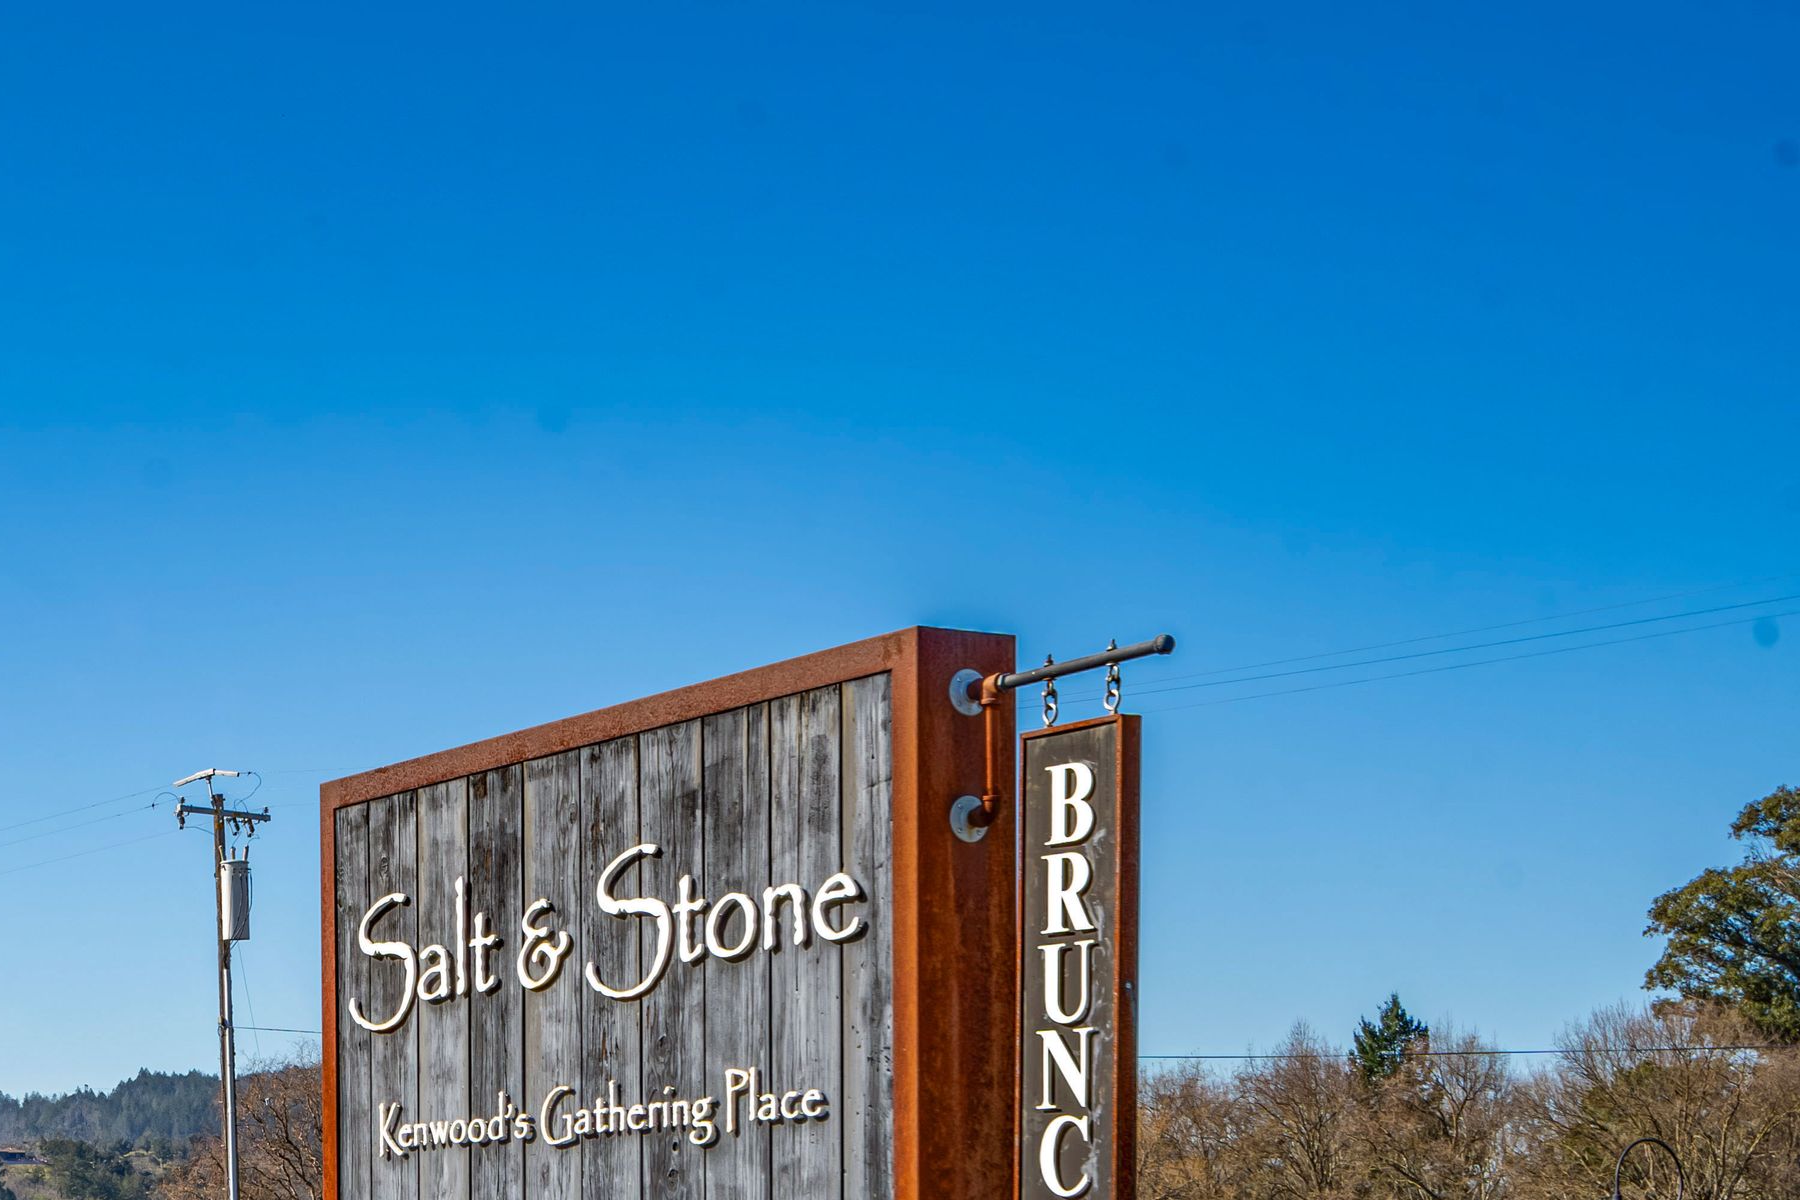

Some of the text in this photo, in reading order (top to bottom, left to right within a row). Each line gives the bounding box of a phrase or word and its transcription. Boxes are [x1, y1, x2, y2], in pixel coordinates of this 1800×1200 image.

[349, 843, 864, 1032] Salt & Stone
[378, 1066, 823, 1157] Kenwood's Gathering Place
